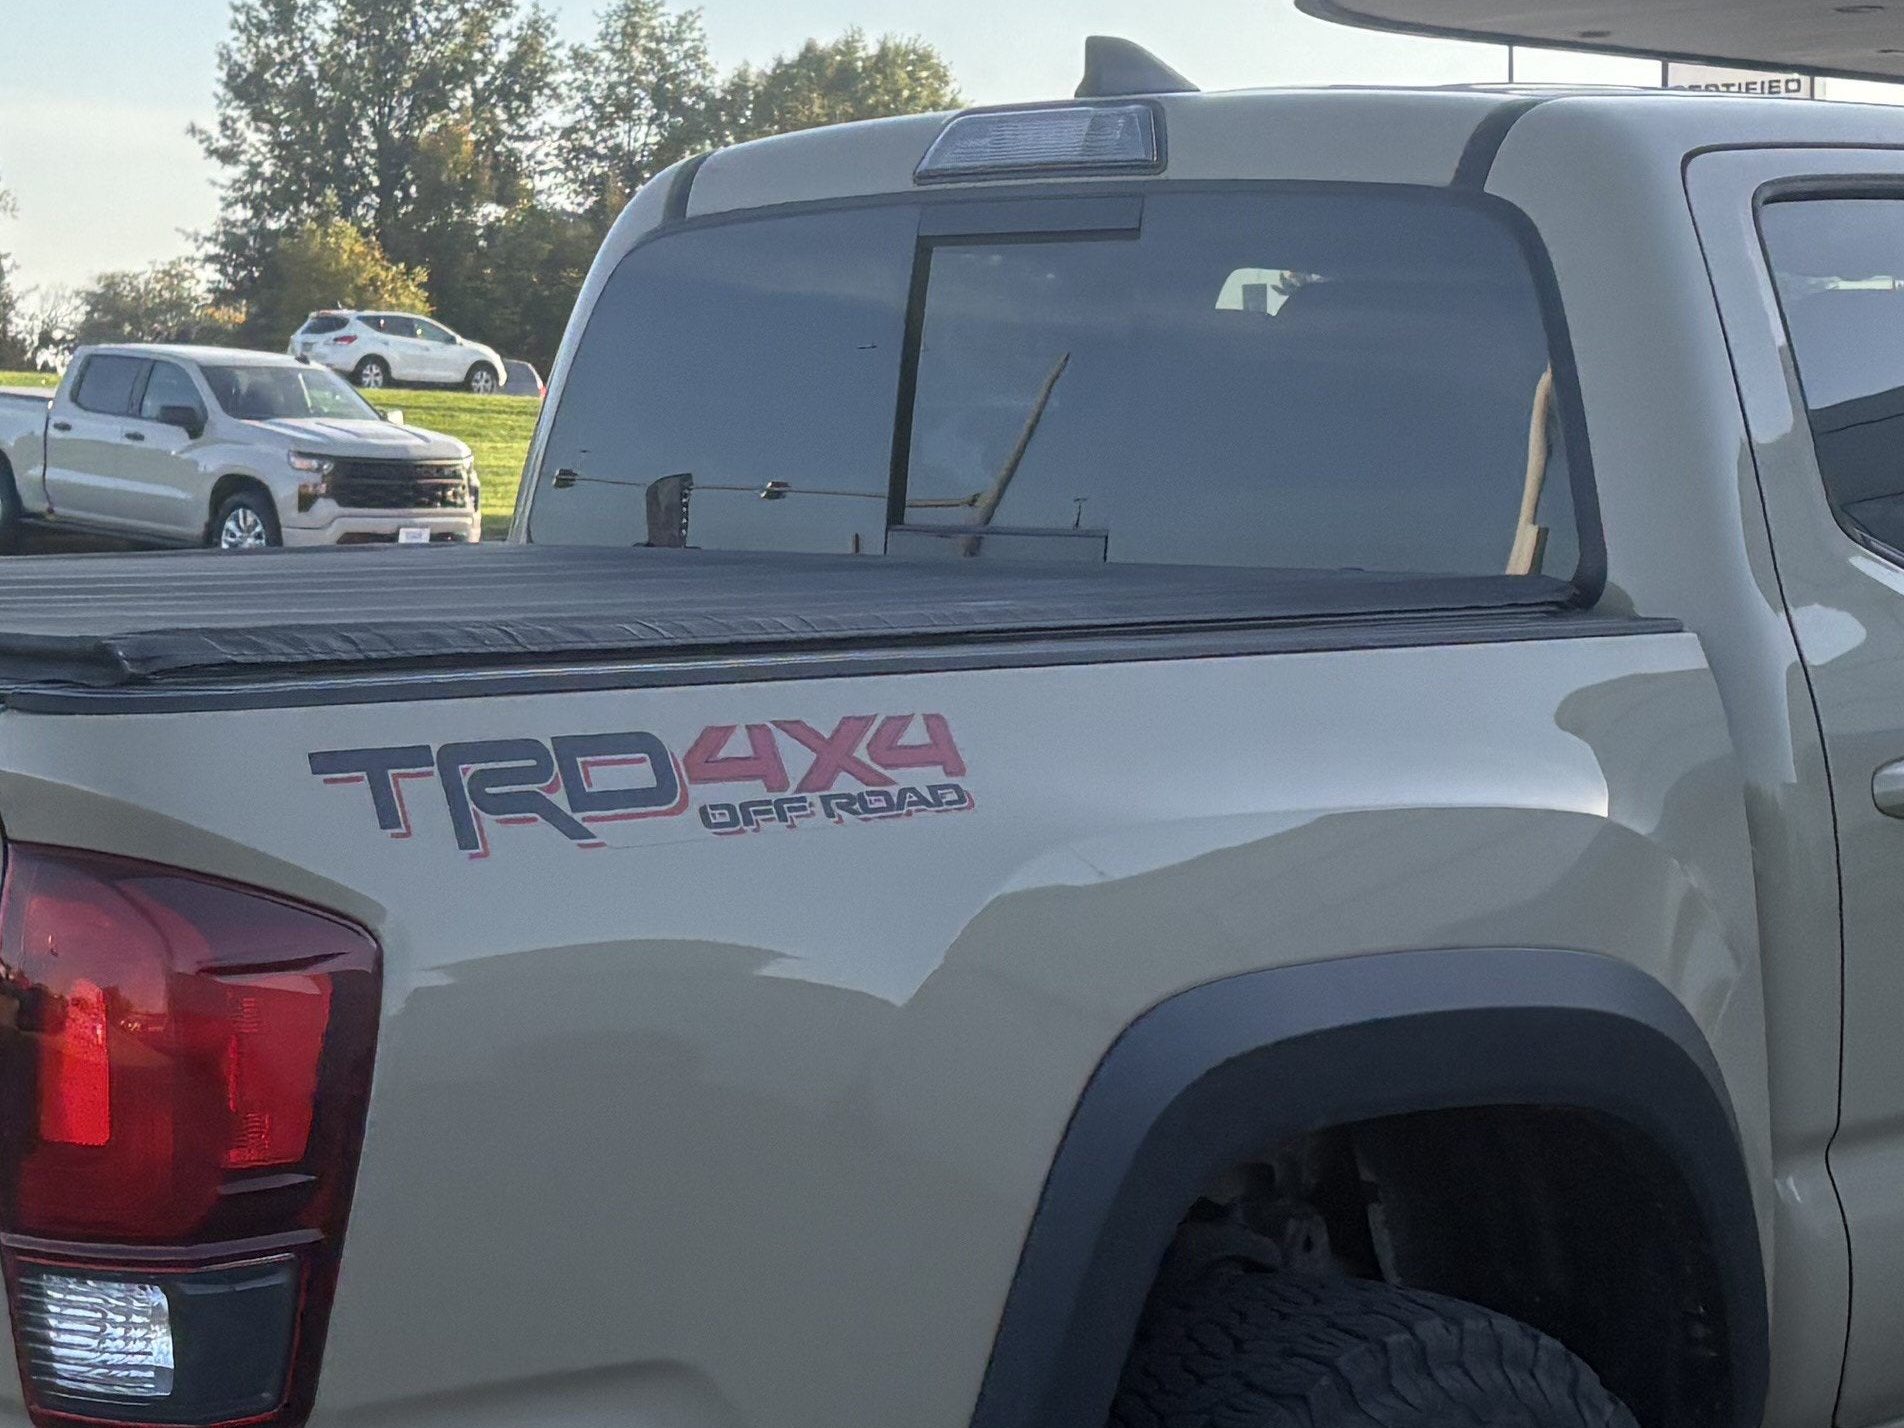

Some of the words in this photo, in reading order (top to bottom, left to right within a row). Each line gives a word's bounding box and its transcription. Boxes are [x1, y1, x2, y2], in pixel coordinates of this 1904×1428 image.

[308, 730, 687, 860] TRD
[699, 794, 816, 835] OFF
[819, 783, 975, 821] ROAD
